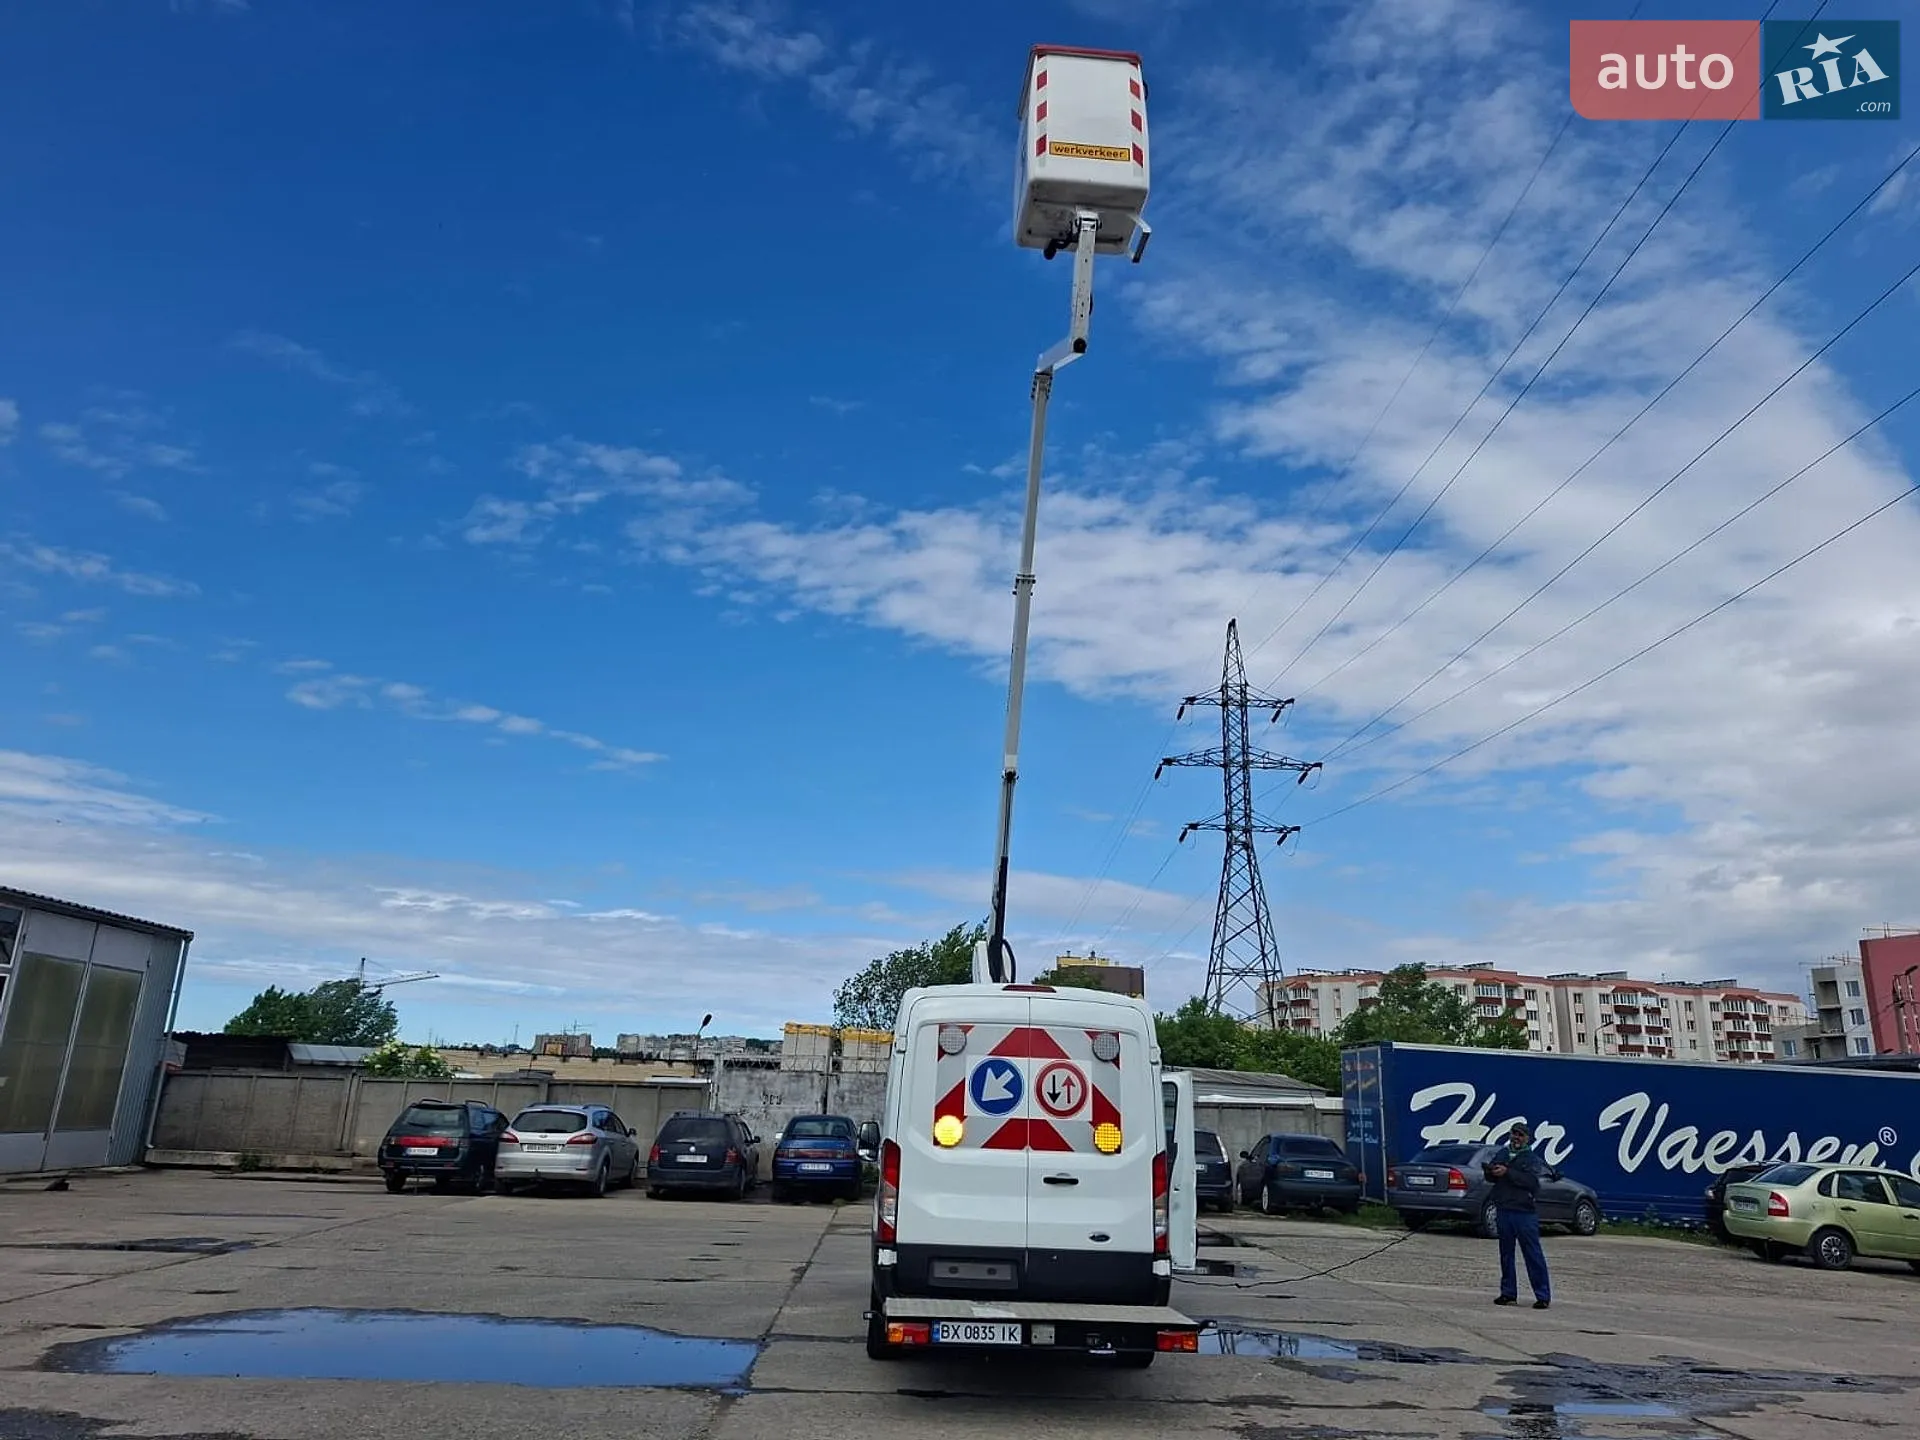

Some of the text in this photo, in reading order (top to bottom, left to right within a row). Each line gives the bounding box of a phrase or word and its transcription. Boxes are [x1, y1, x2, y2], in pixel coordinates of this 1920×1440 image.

[1054, 145, 1124, 158] werkverkeer
[1599, 1092, 1887, 1174] Vaessen
[941, 1324, 1018, 1342] BX 0835 IK
